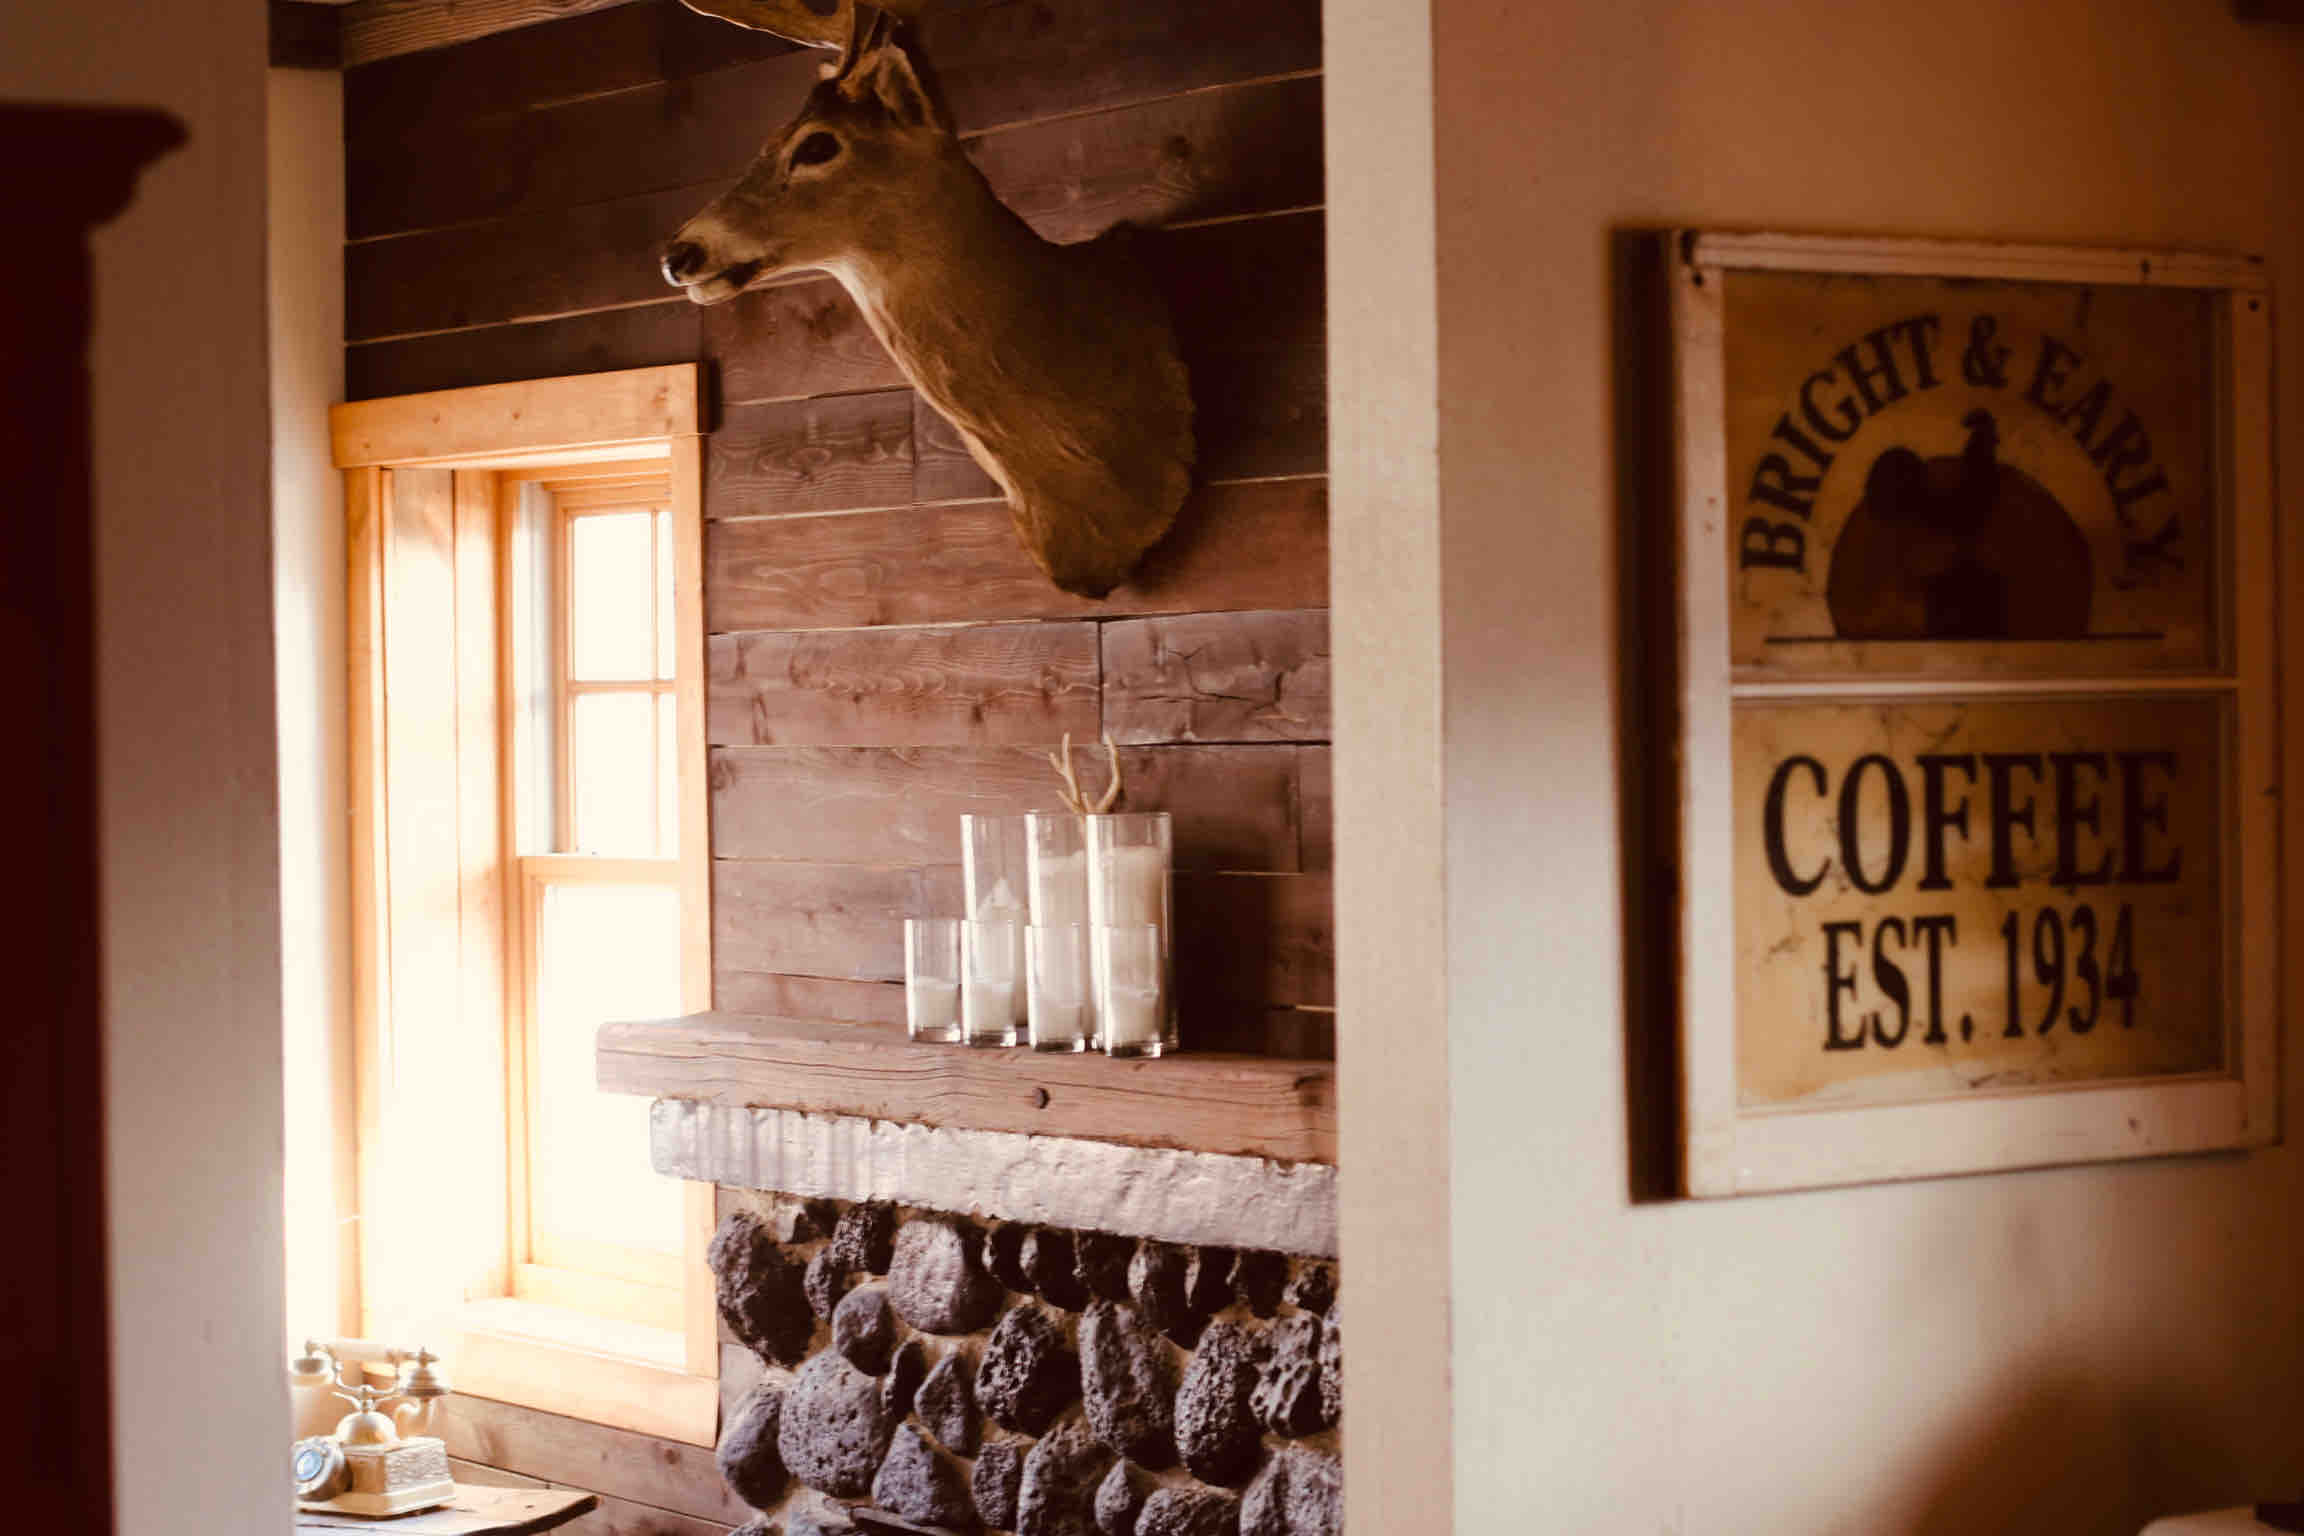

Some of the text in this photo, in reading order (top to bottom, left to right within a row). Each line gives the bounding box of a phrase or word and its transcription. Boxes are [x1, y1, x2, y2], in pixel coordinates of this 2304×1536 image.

[1739, 314, 2186, 592] BRIGHT & EARLY
[1763, 751, 2182, 897] COFFEE
[1820, 903, 2140, 1052] EST. 1934
